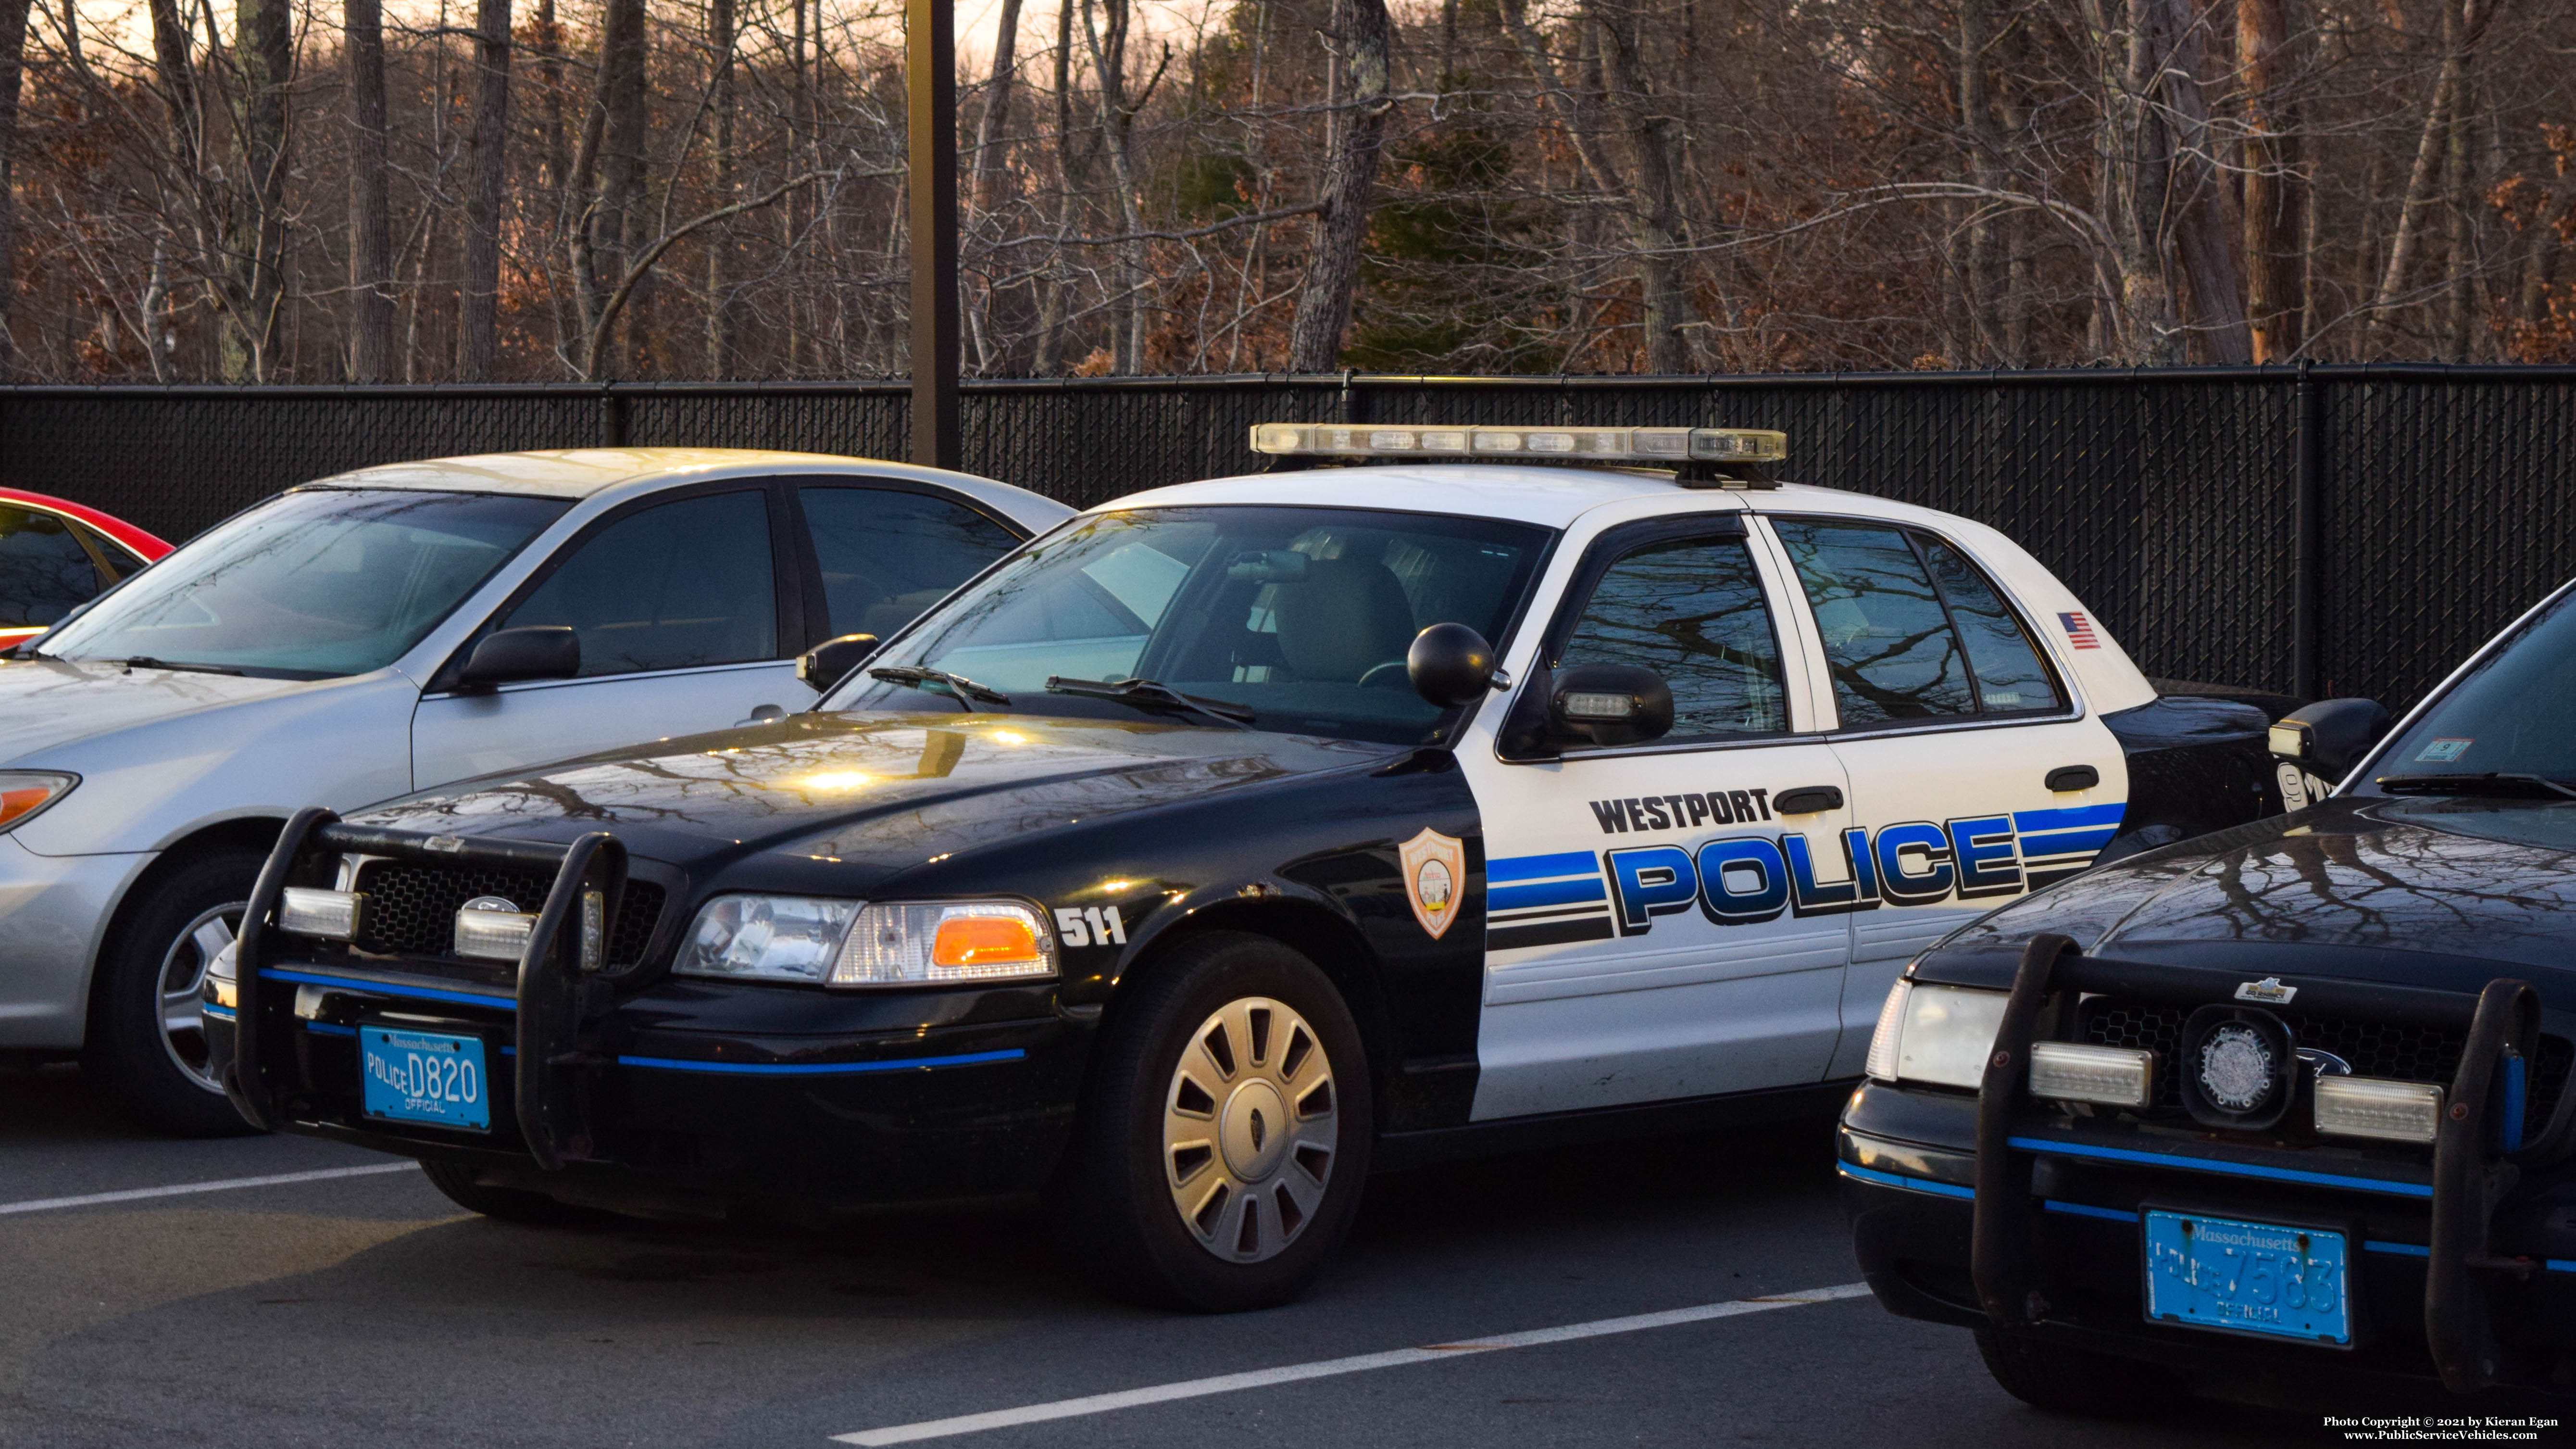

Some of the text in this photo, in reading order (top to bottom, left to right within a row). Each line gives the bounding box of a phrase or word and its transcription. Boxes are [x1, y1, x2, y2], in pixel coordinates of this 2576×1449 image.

[1588, 788, 1772, 834] WESTPORT
[1603, 813, 2024, 937] POLICE
[1054, 906, 1127, 947] 511
[388, 1033, 456, 1054] Massachusetts
[368, 1051, 477, 1104] POLICE D820
[405, 1097, 446, 1114] OFFICIAL
[2191, 1224, 2301, 1252] Massachusetts
[2223, 1247, 2335, 1312] 7583
